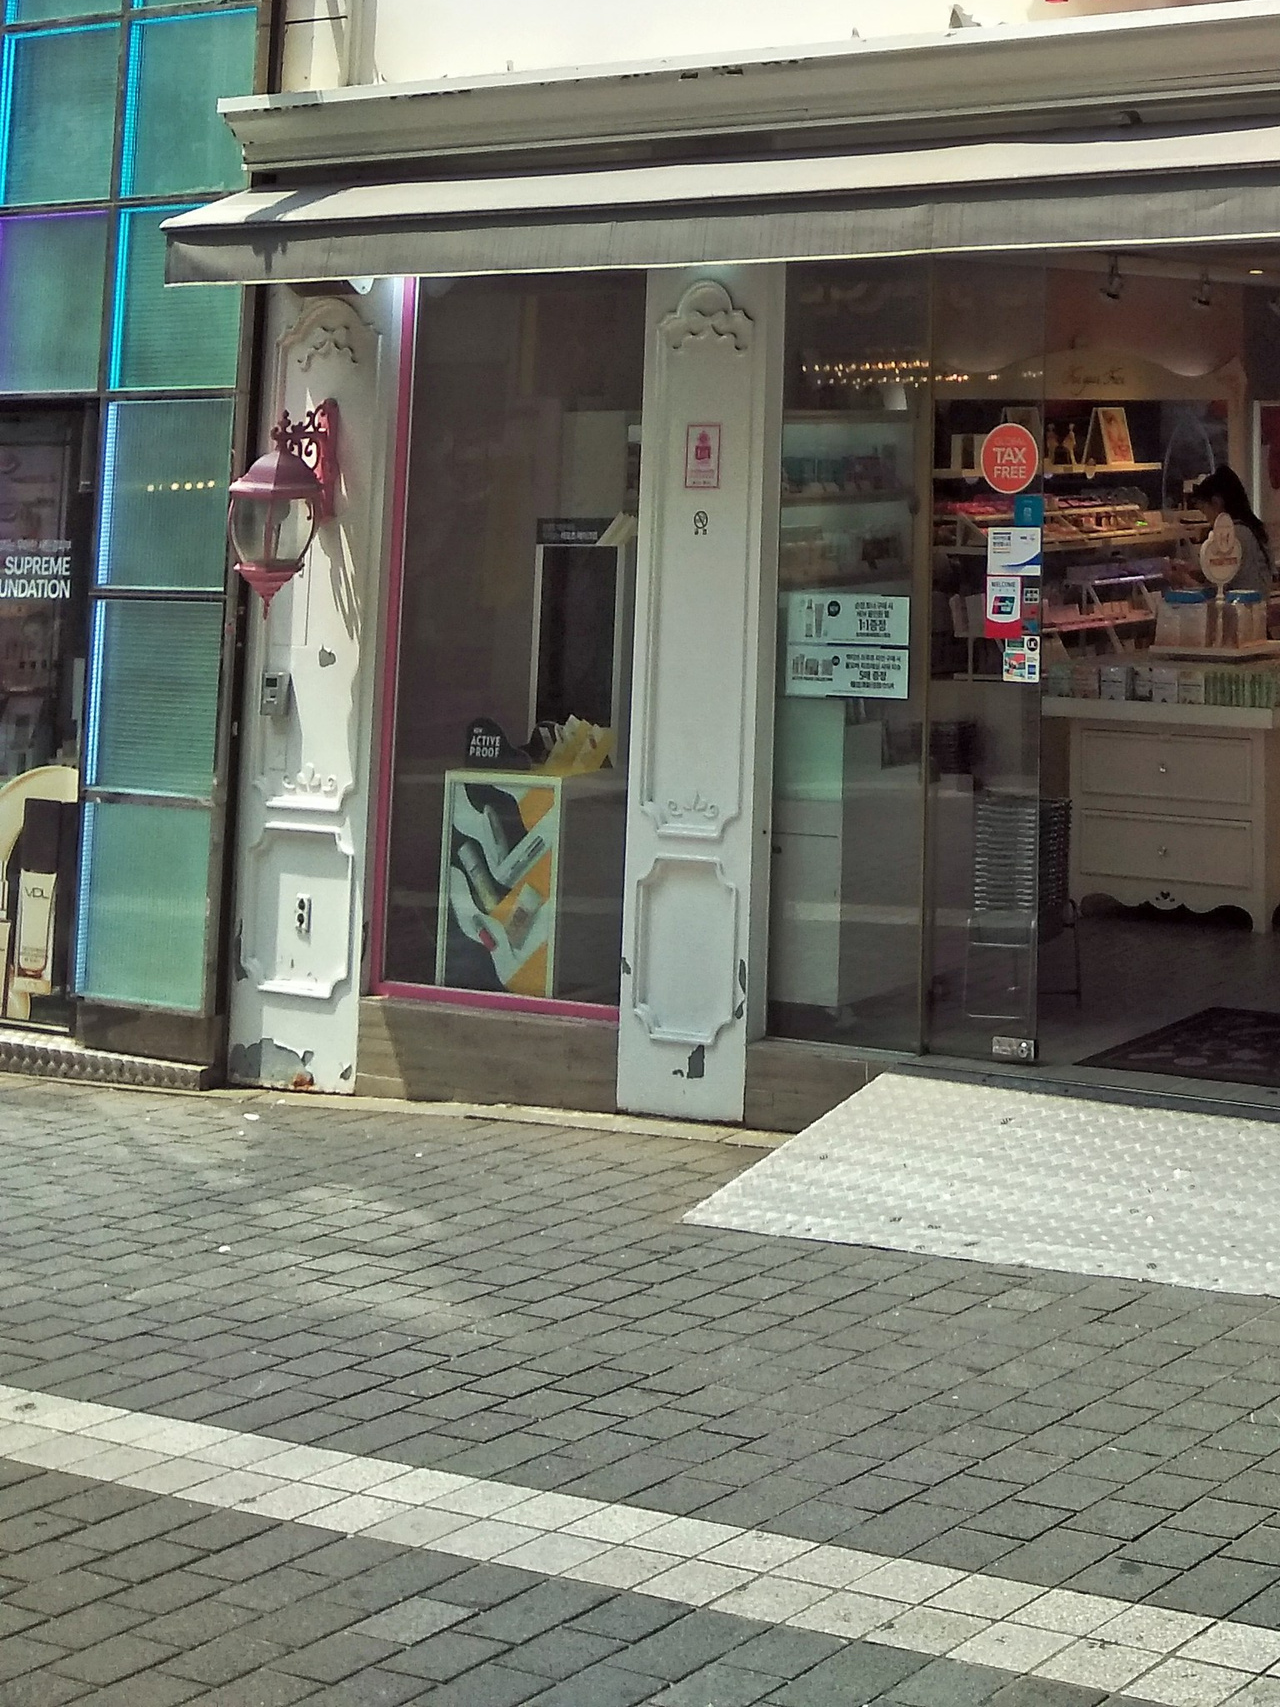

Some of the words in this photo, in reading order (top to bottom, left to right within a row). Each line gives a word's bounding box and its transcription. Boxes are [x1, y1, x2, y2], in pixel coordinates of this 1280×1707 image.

[993, 447, 1027, 464] TAX
[994, 466, 1027, 479] FREE
[5, 556, 71, 575] SUPREME
[470, 735, 500, 746] ACTIVE
[469, 747, 500, 758] PROOF
[25, 887, 50, 899] VDL
